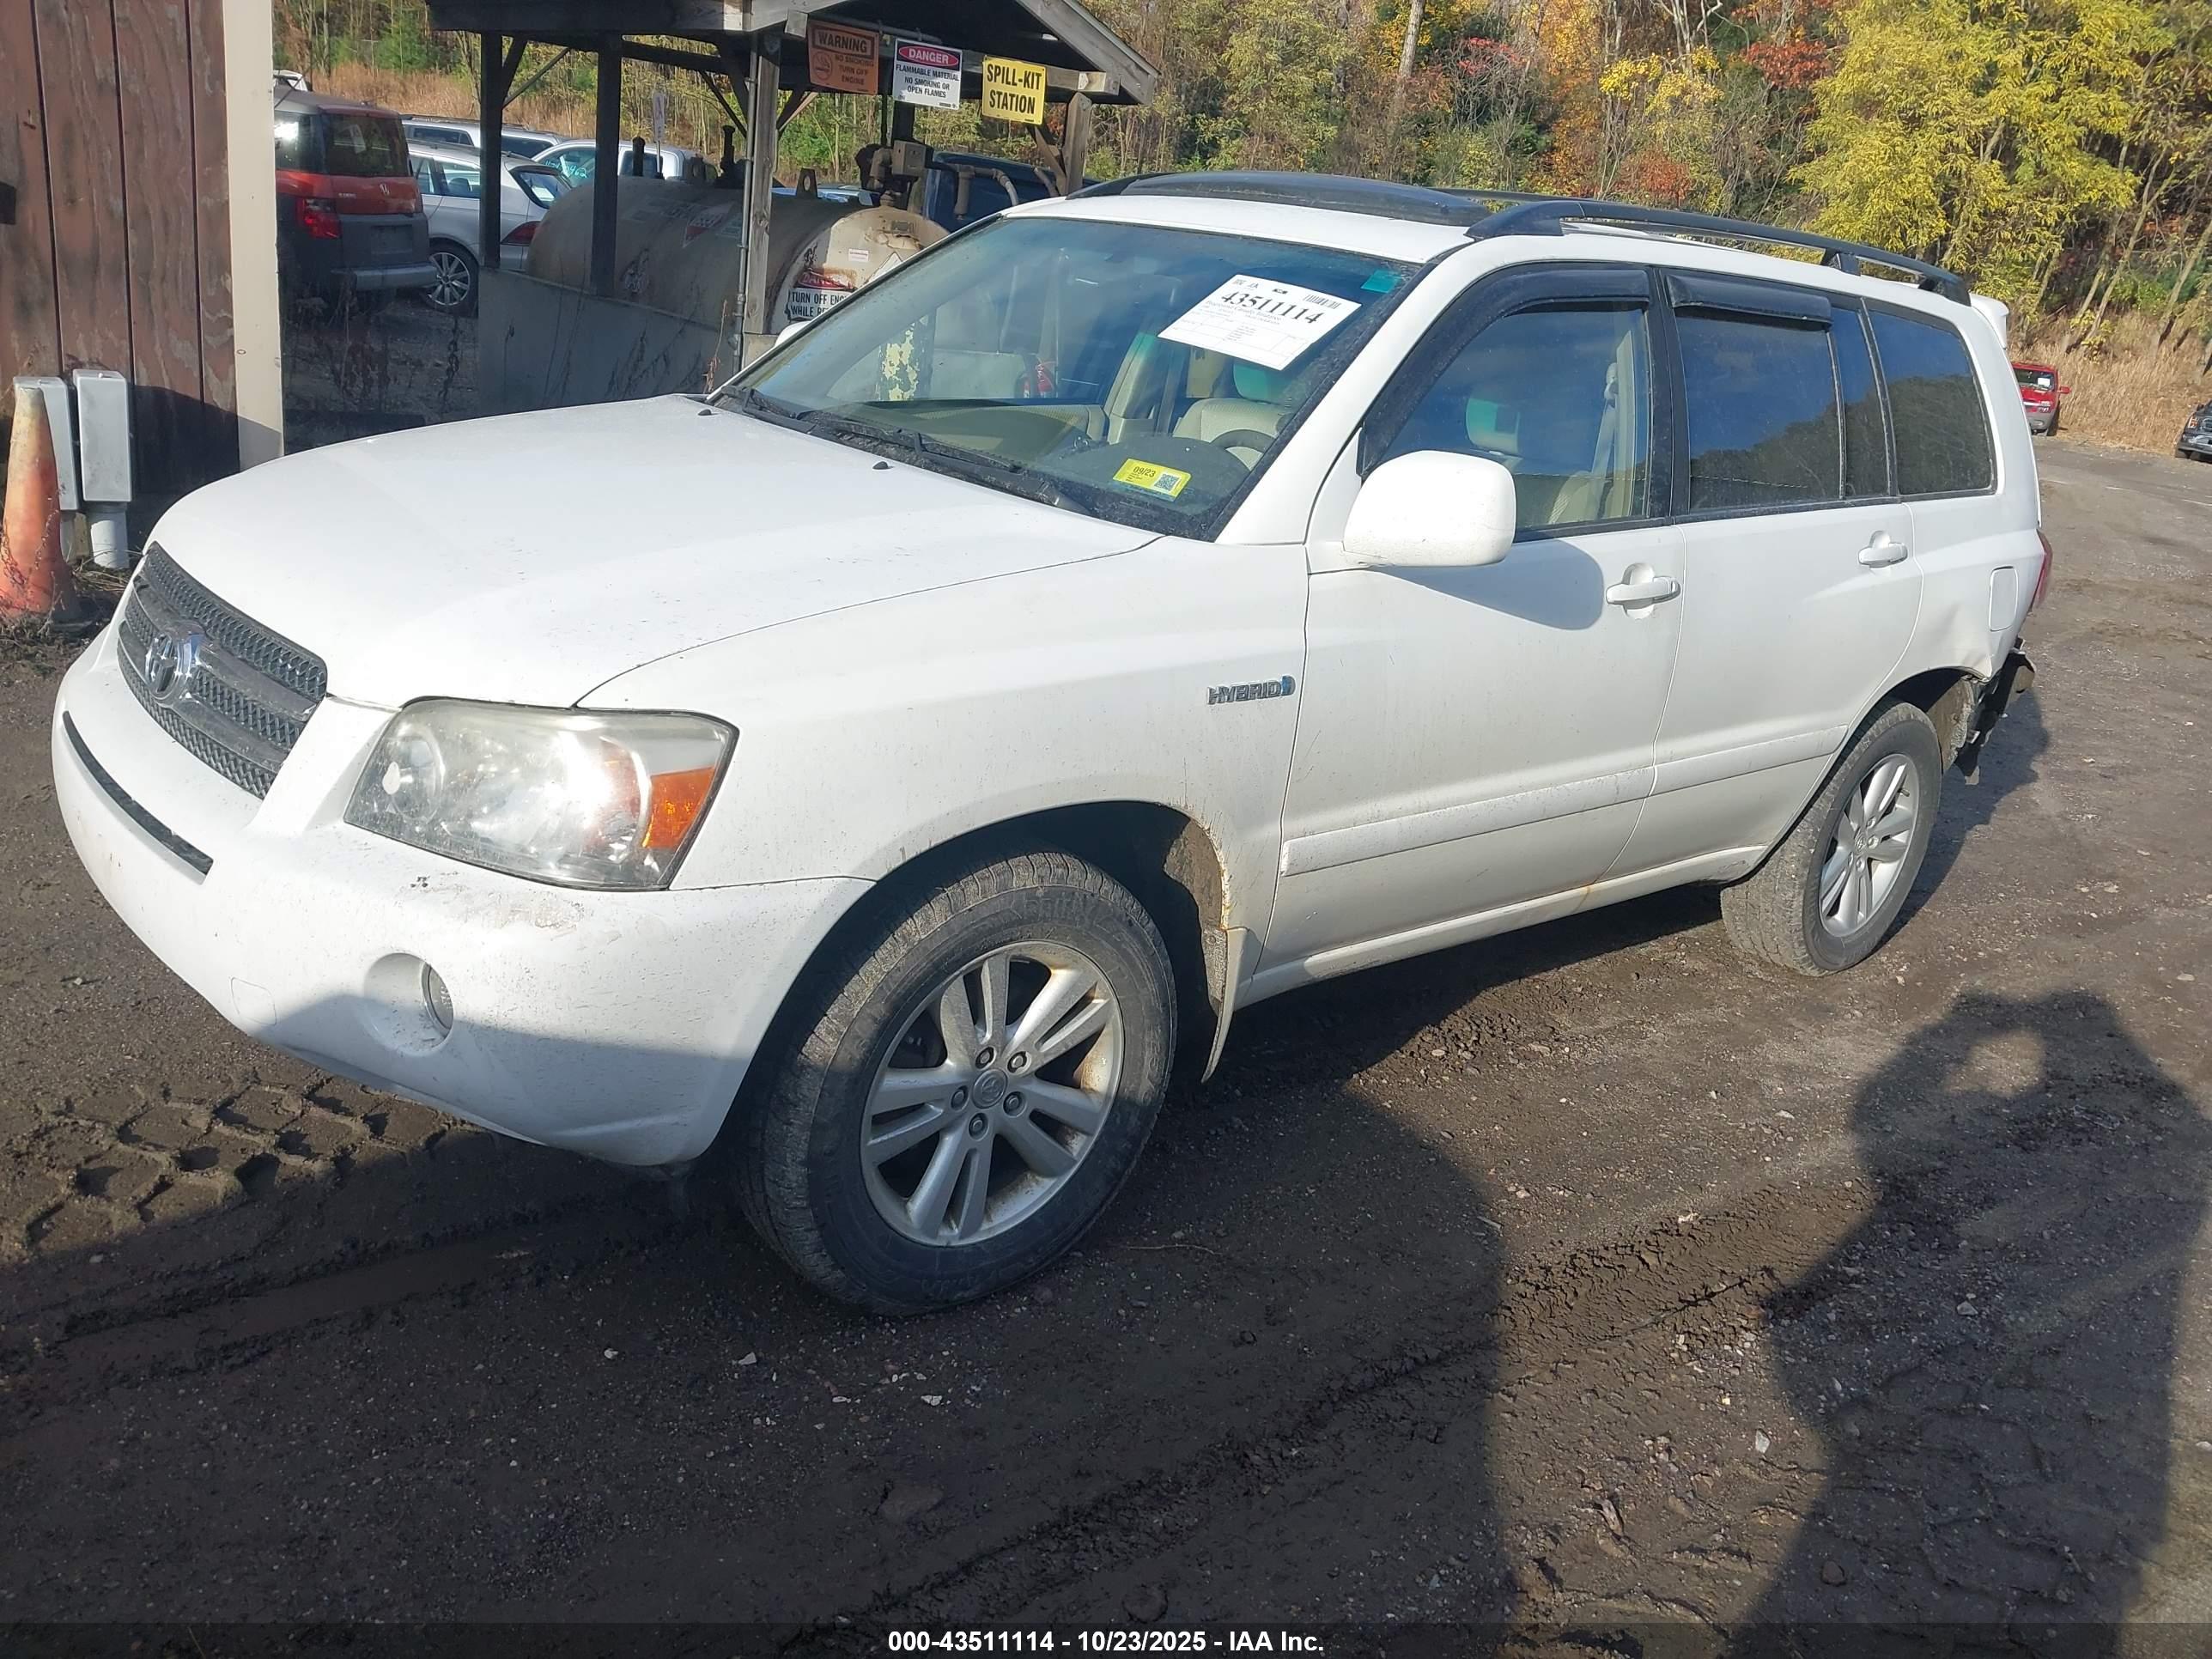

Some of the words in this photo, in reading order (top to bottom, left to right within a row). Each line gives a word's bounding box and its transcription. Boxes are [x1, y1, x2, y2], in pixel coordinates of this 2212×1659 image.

[817, 31, 867, 53] WARNING
[908, 48, 949, 64] DANGER
[839, 64, 855, 75] TURN
[896, 64, 931, 76] FLAMMABLE
[932, 70, 959, 82] MATERIAL
[842, 75, 865, 86] ENGINE
[915, 77, 941, 89] SMOKING
[942, 82, 950, 90] OR
[987, 64, 1042, 90] SPILL-KIT
[907, 86, 922, 94] OPEN
[924, 88, 946, 99] FLAMES
[989, 89, 1036, 114] STATION
[792, 292, 811, 304] TURN
[813, 294, 827, 305] OFF
[790, 305, 813, 317] WHILE
[1221, 291, 1324, 324] 43511114
[1133, 466, 1156, 478] 09/23
[1207, 680, 1282, 705] HYBRID
